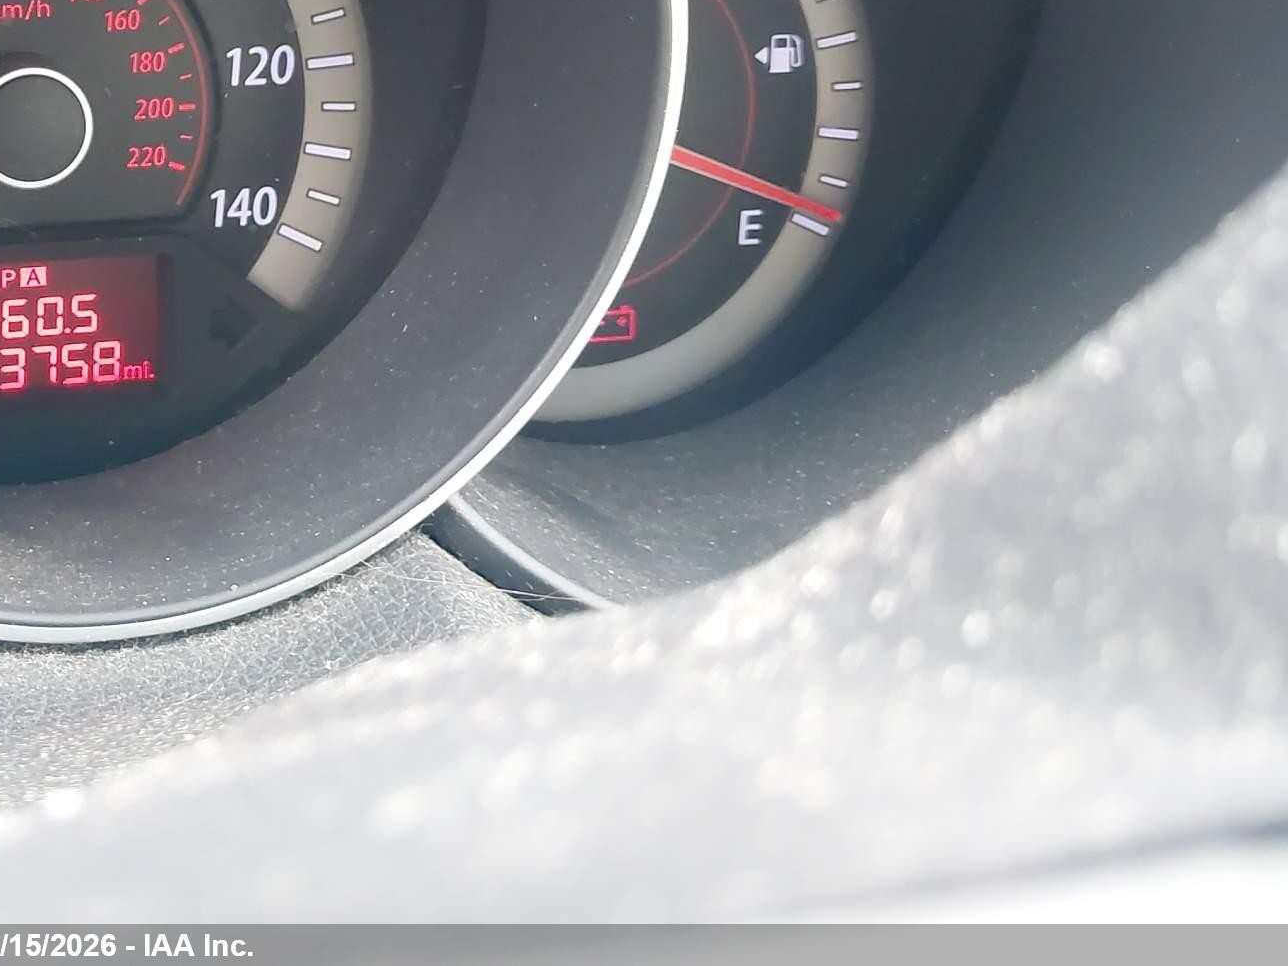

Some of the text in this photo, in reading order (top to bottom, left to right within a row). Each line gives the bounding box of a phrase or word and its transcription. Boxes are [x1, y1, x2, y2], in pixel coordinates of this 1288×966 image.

[105, 9, 140, 31] 160
[130, 51, 165, 73] 180
[226, 44, 295, 88] 120
[134, 98, 174, 120] 200
[127, 146, 166, 168] 220
[211, 187, 277, 228] 140
[738, 209, 762, 245] E
[23, 267, 43, 287] A
